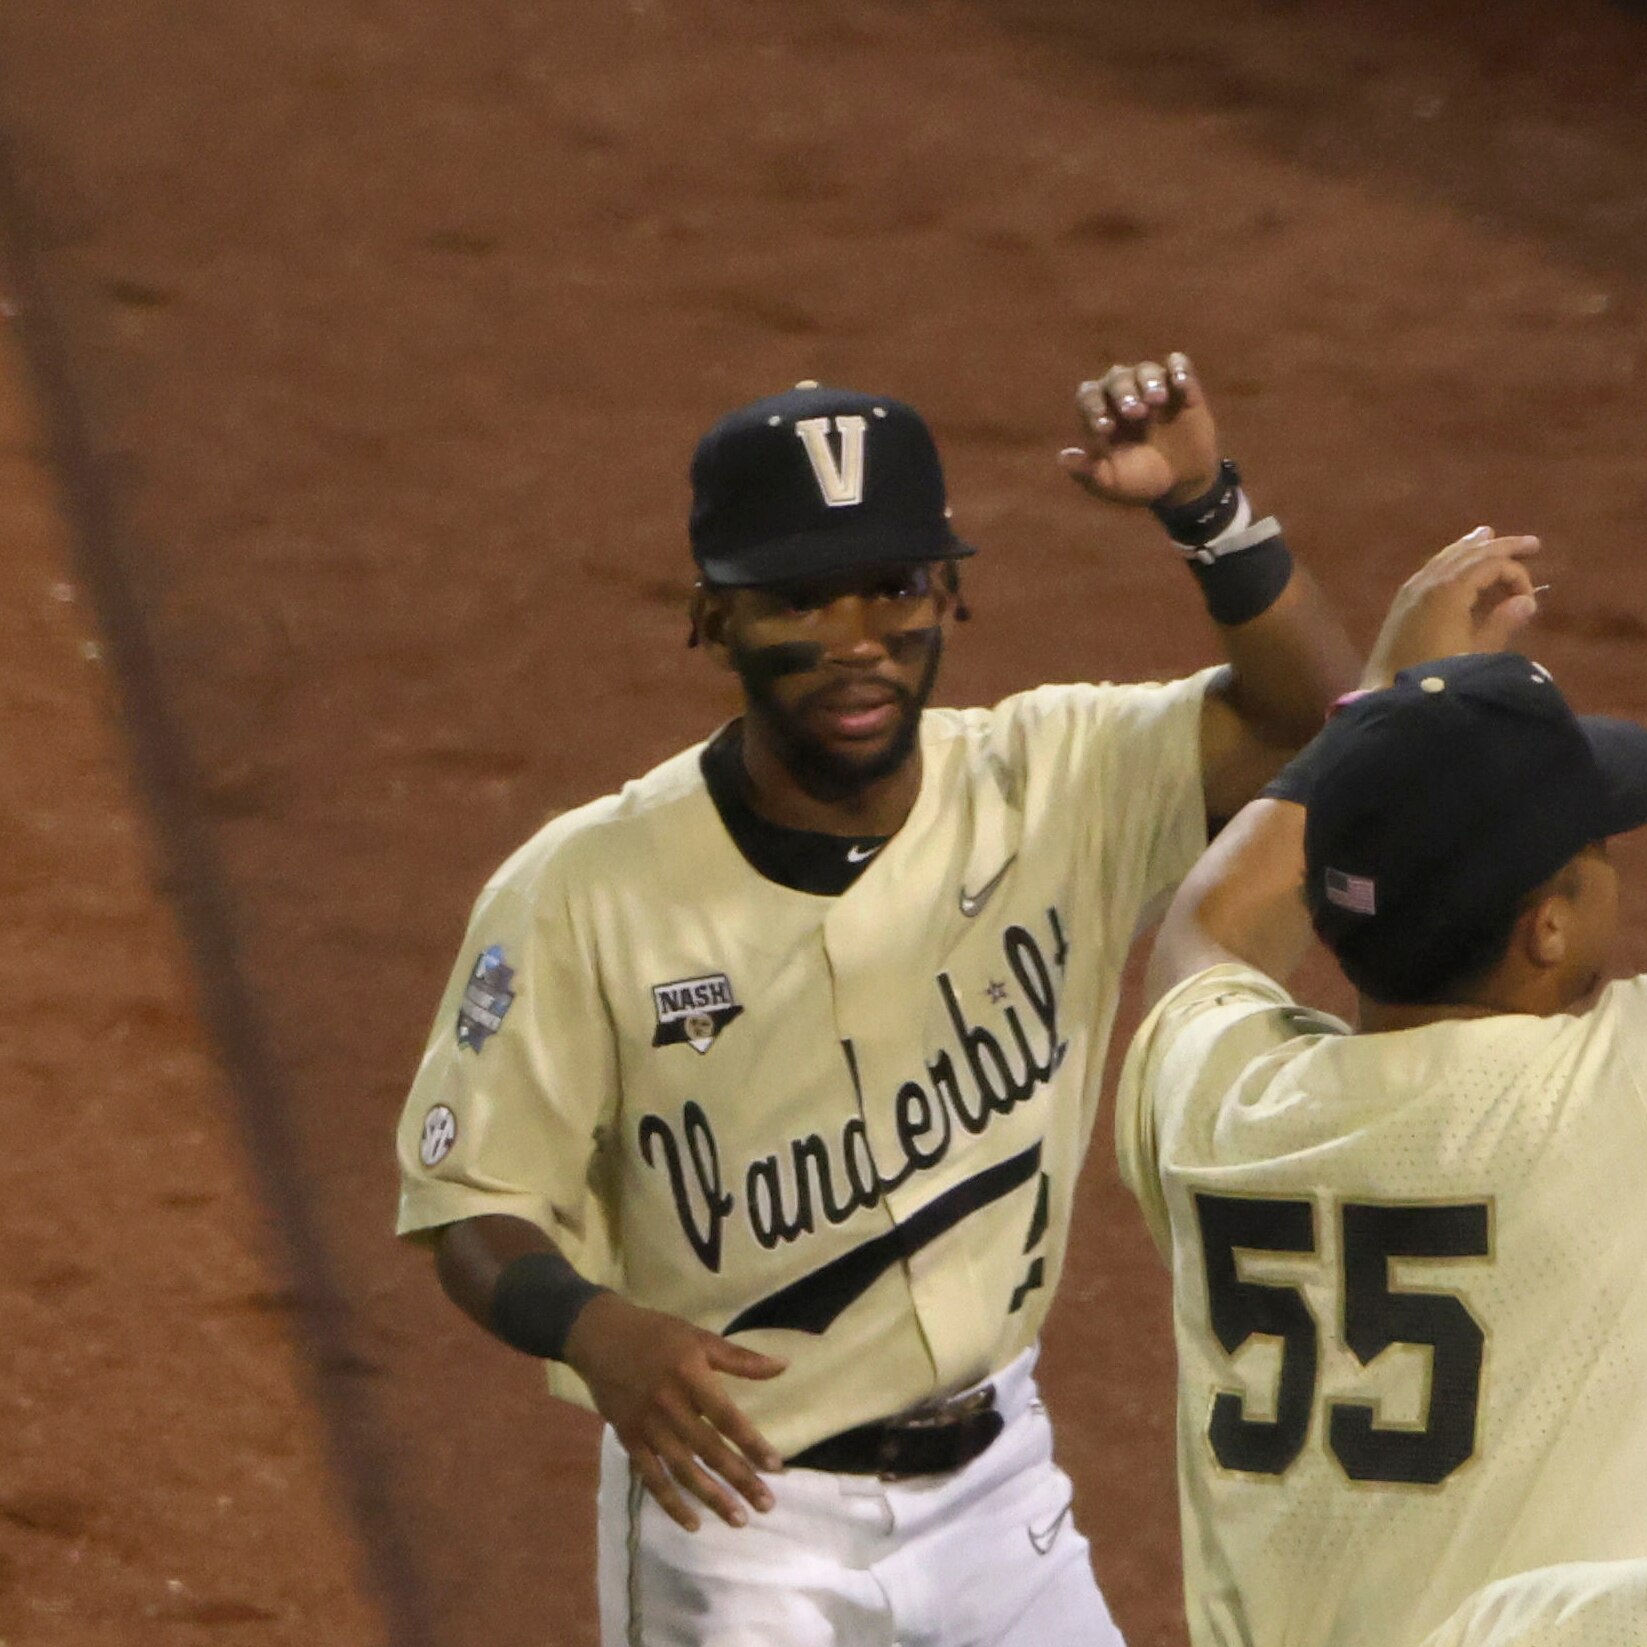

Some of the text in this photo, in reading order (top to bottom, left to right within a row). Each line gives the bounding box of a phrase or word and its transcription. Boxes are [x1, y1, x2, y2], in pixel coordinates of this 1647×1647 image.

[795, 414, 866, 507] V
[656, 980, 728, 1013] NASH
[1188, 1187, 1496, 1494] 55
